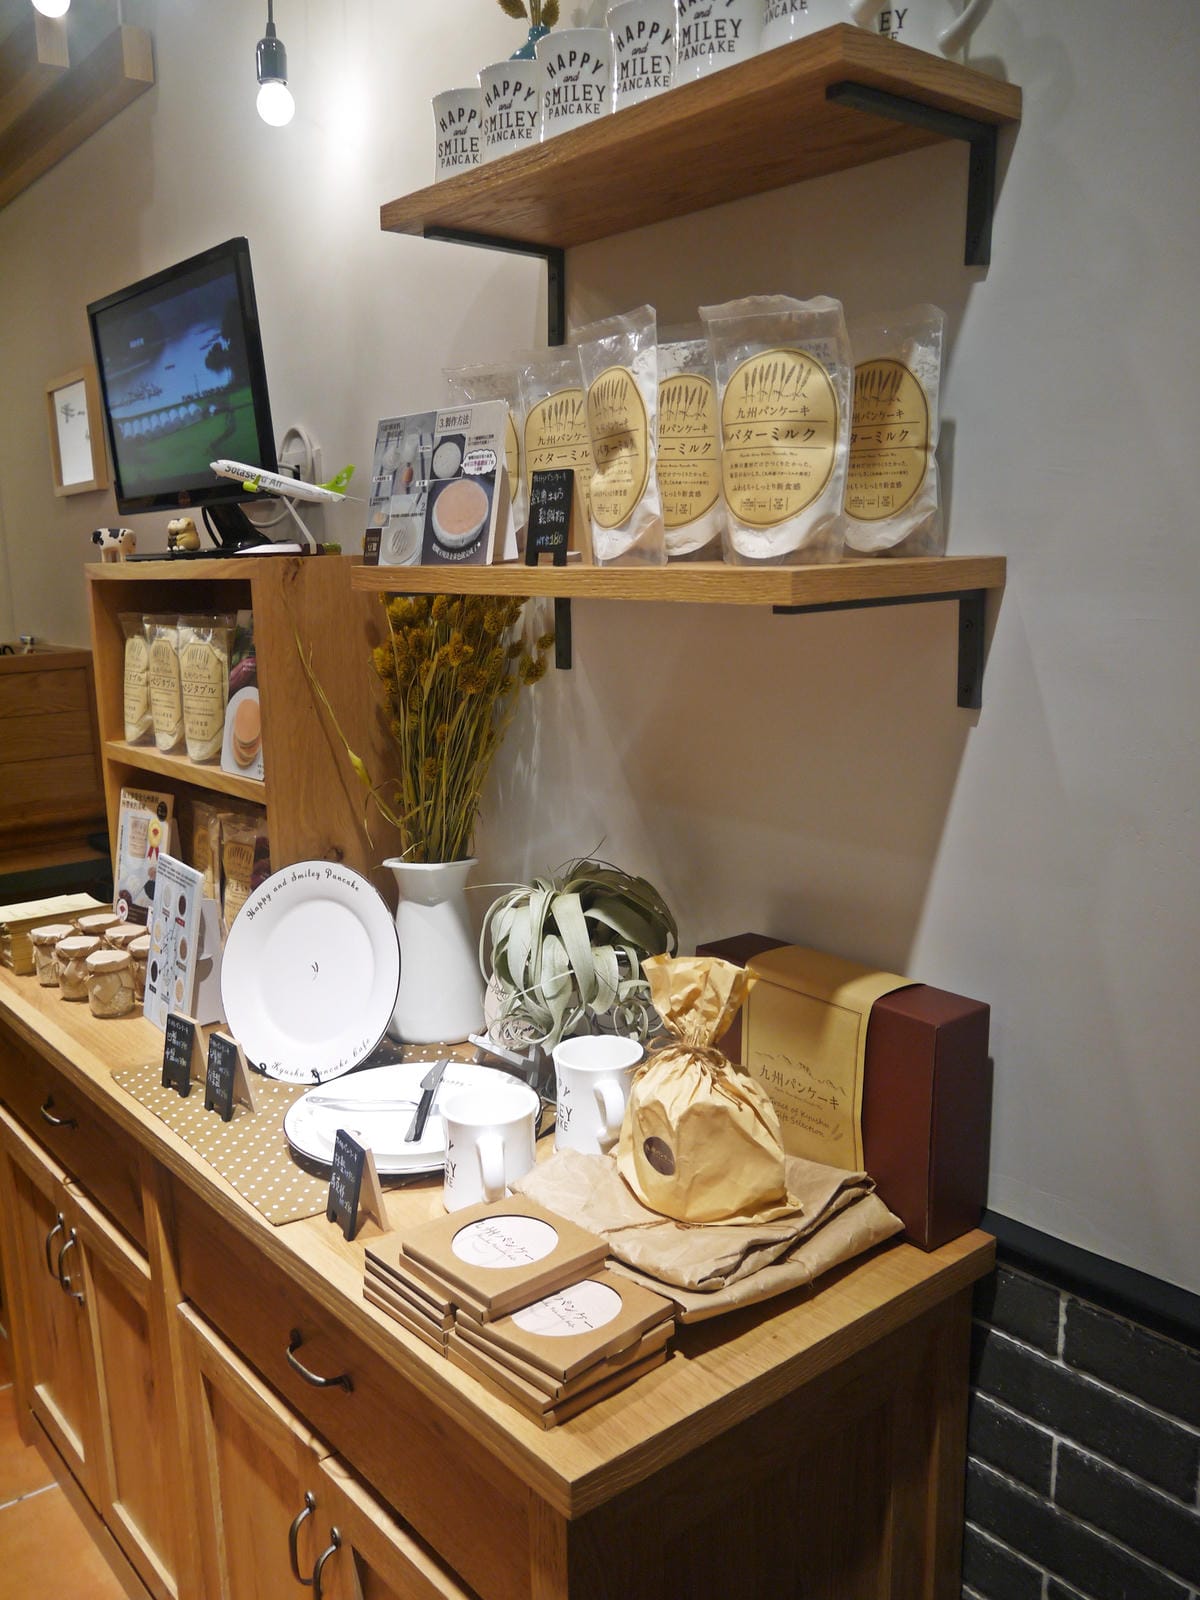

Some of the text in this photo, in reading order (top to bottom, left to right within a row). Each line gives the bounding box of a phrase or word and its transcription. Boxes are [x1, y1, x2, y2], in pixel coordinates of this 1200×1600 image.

[616, 20, 672, 52] HAPPY
[679, 18, 743, 49] MILEY
[631, 42, 649, 56] and
[546, 50, 604, 79] HAPPY
[562, 71, 581, 83] and
[484, 80, 536, 107] HAPPY
[544, 84, 606, 109] SMILEY
[498, 100, 513, 111] and
[548, 102, 601, 120] PANCAKE
[453, 126, 468, 137] and
[484, 110, 538, 136] SMILEY
[486, 128, 533, 146] PANCAKE
[736, 405, 810, 419] 九州パンケーキ
[729, 426, 816, 444] バターミルク
[246, 867, 360, 921] Happy and Smiley Pancake
[271, 1060, 305, 1079] Kyushu
[311, 1059, 350, 1079] ancake
[759, 1064, 840, 1111] 九州パンケーキ
